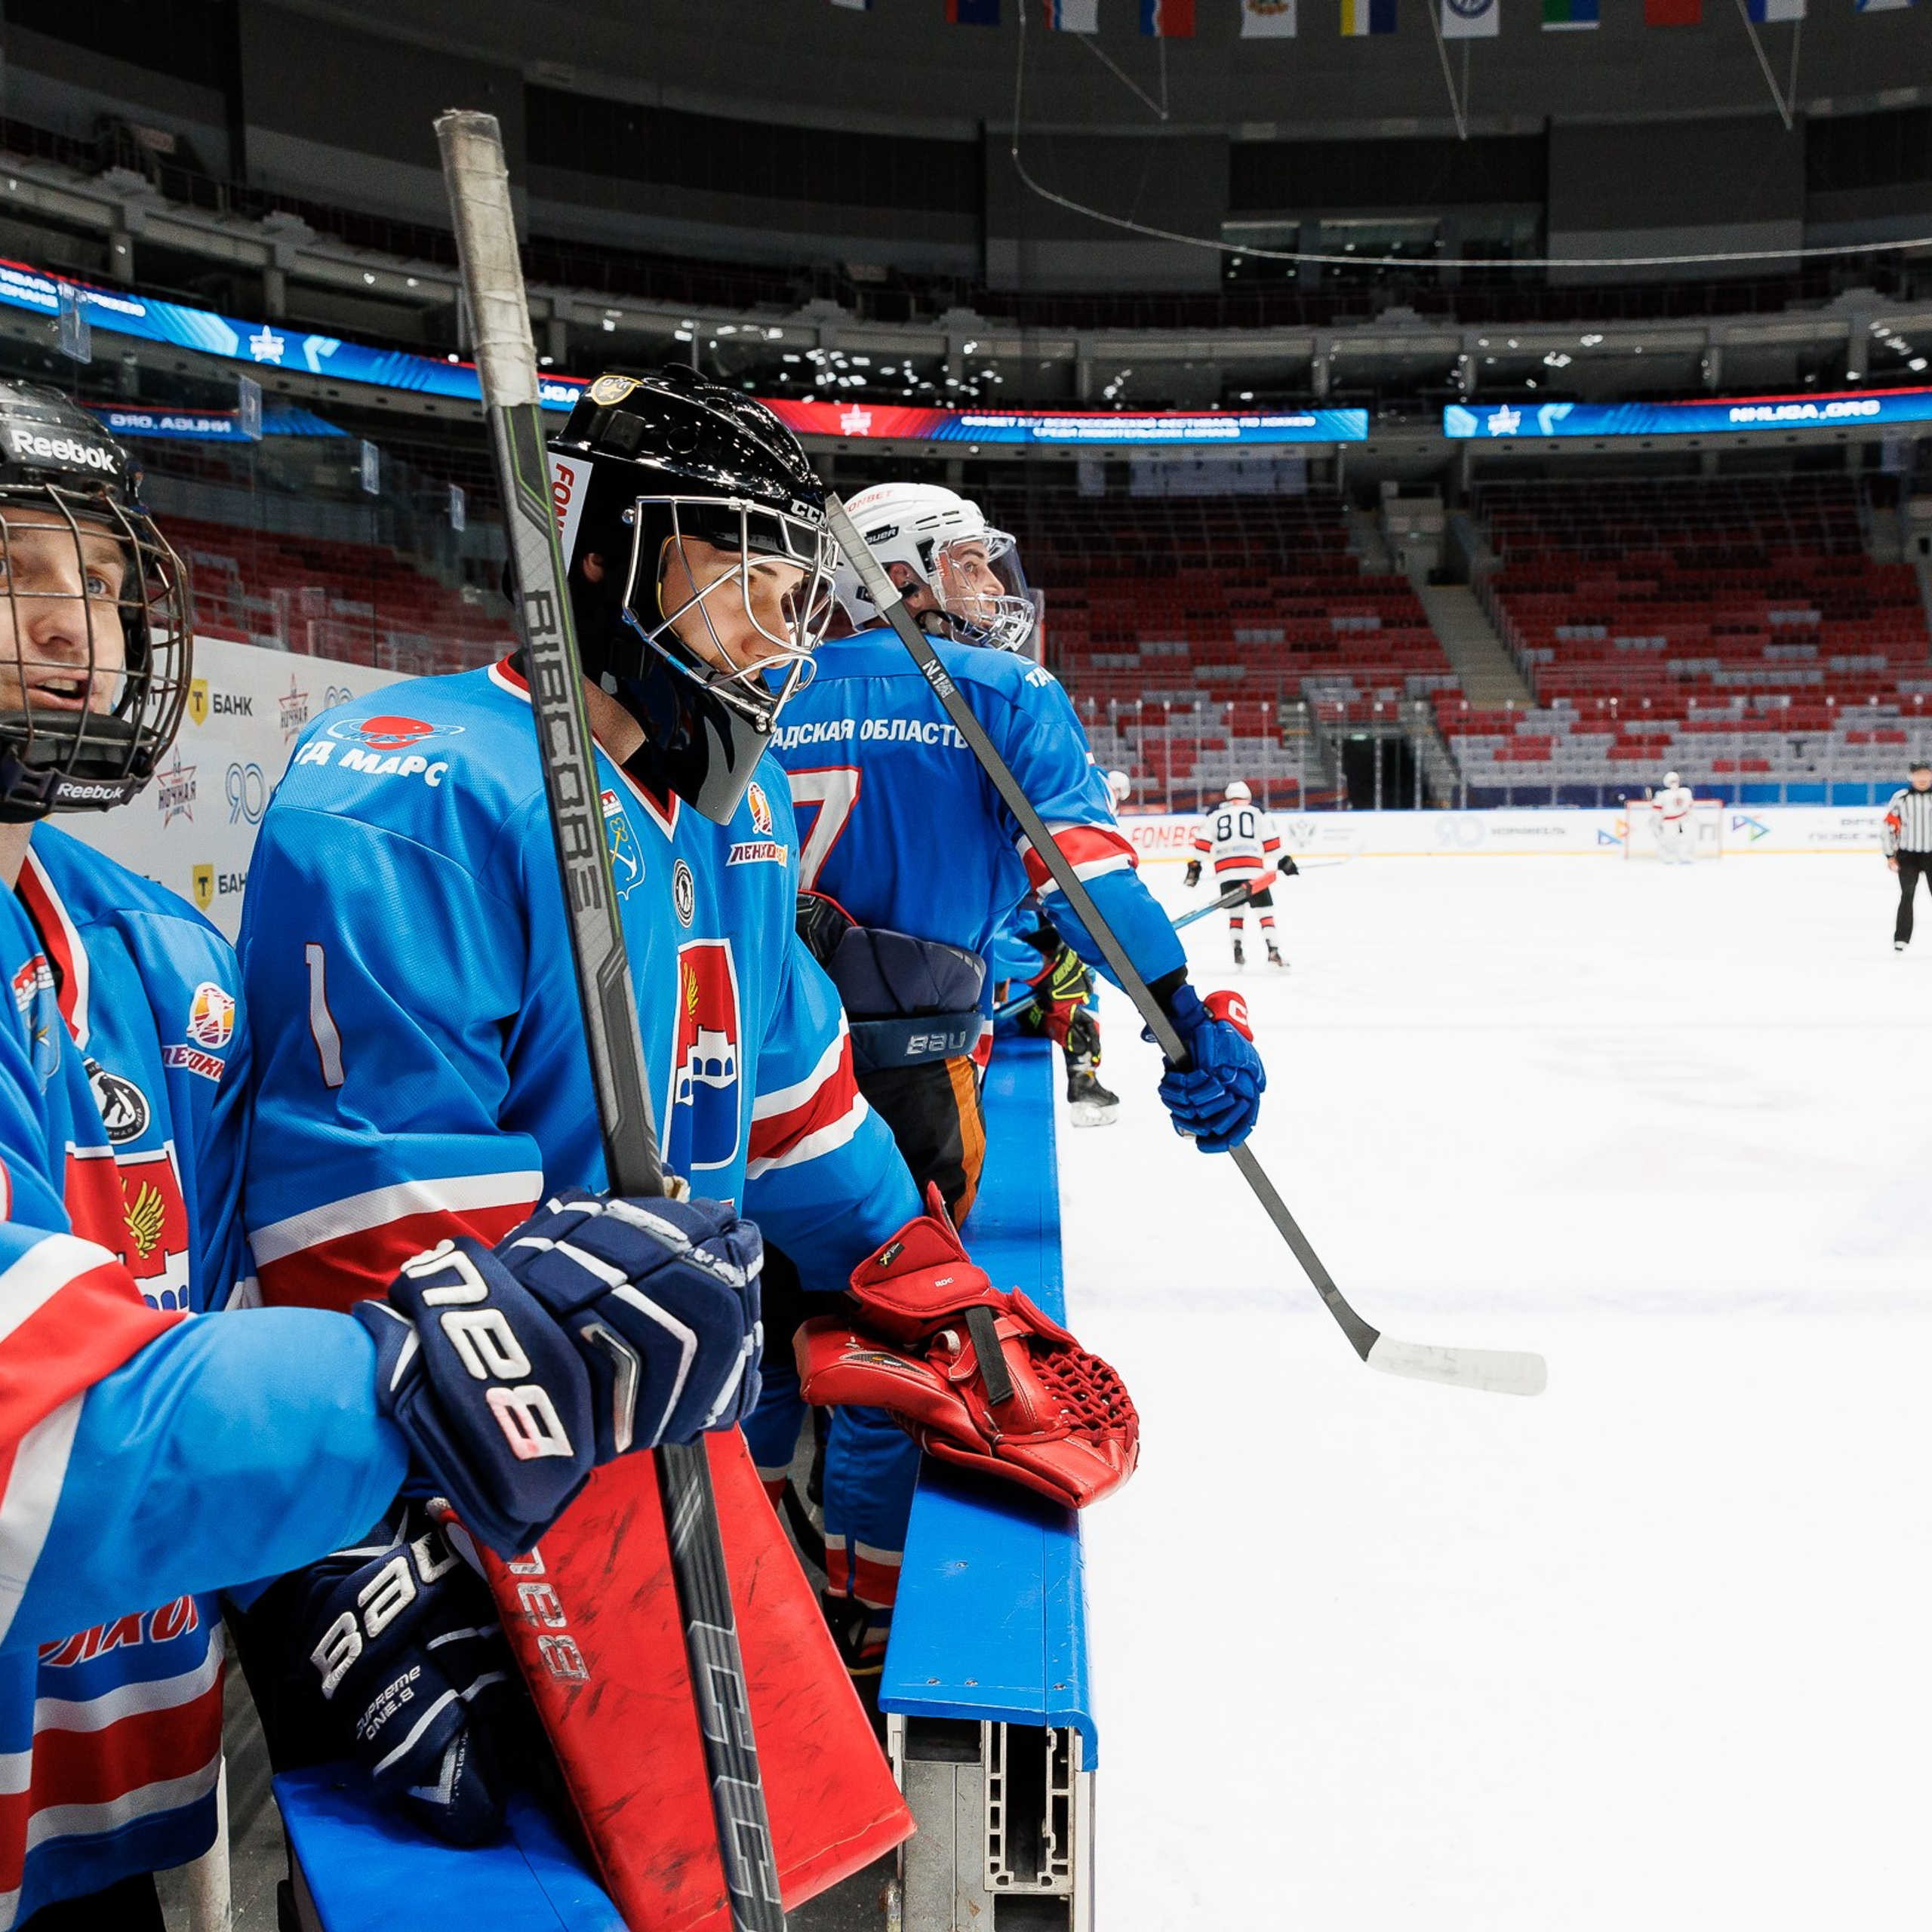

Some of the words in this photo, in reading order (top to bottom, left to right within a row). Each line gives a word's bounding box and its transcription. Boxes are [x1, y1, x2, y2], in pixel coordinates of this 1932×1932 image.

[11, 430, 118, 474] Reebok
[552, 463, 574, 542] FON
[791, 499, 828, 528] CCM
[213, 694, 253, 716] БАНК
[770, 718, 855, 750] АДСКАЯ
[860, 719, 968, 749] ОБЛАСТЬ
[338, 748, 449, 787] МАРС
[57, 782, 125, 799] Reebok
[786, 764, 863, 891] 7
[1217, 811, 1254, 841] 80
[304, 942, 345, 1089] 1
[366, 1687, 414, 1740] ONE.8
[688, 1618, 787, 1931] CC
